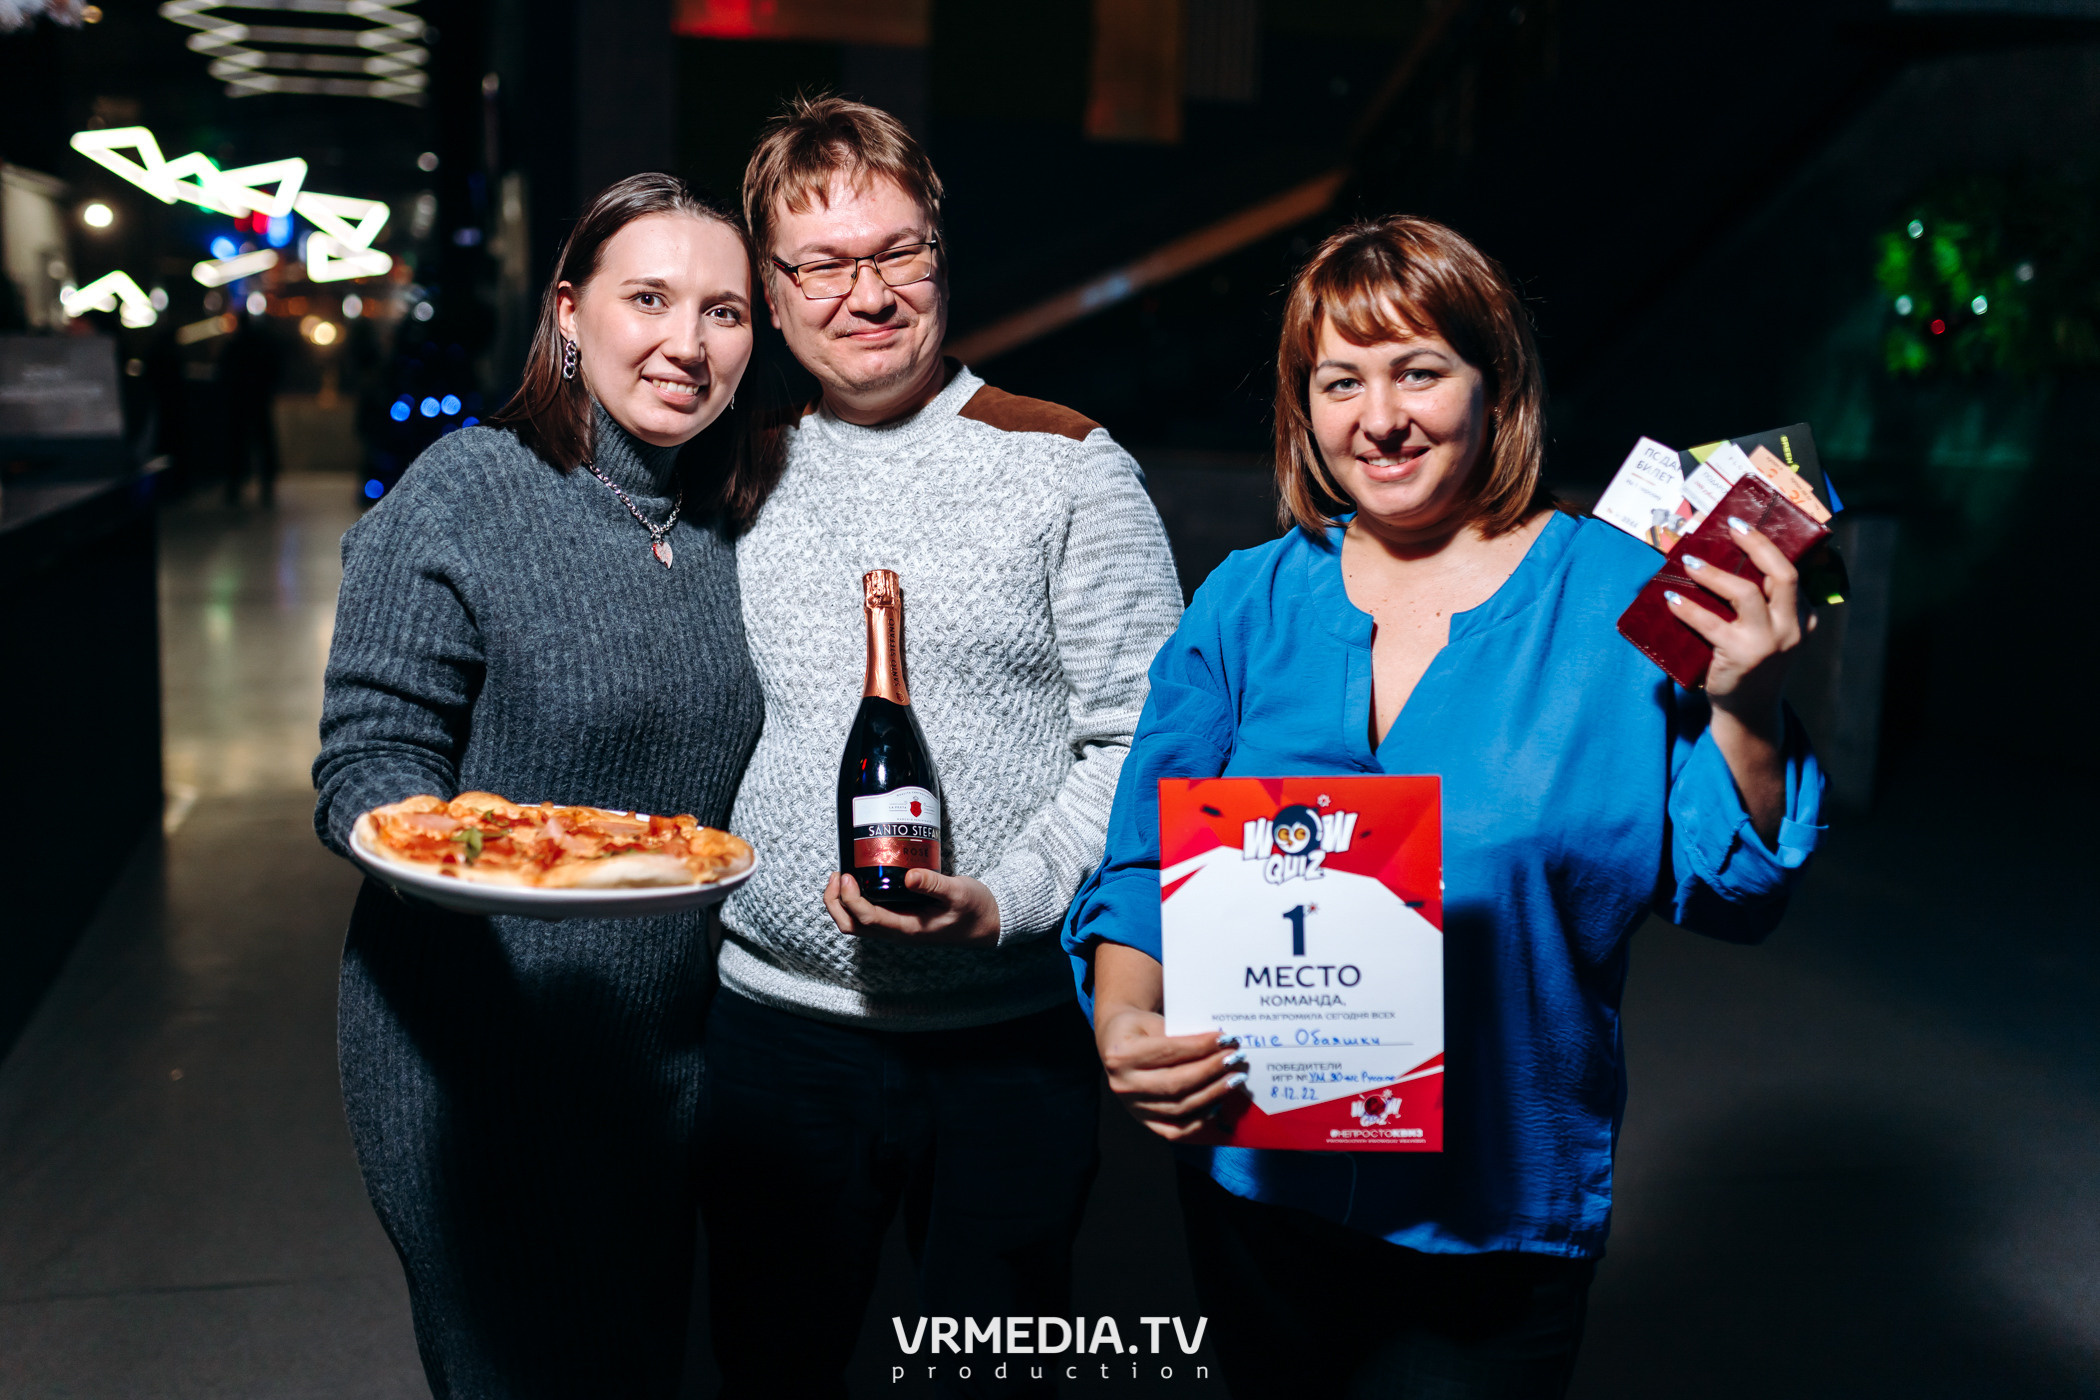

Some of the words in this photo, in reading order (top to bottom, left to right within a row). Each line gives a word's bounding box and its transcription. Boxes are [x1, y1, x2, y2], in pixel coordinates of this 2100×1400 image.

[868, 825, 908, 837] SANTO
[1264, 850, 1326, 885] QUIZ
[1282, 904, 1306, 957] 1
[1244, 965, 1362, 988] МЕСТО
[1211, 1014, 1257, 1022] КОТОРАЯ
[1259, 1013, 1323, 1021] РАЗГРОМИЛА
[1325, 1012, 1370, 1021] СЕГОДНЯ
[1372, 1011, 1396, 1020] ВСЕХ
[1266, 1062, 1343, 1072] ПОБЕДИТЕЛИ
